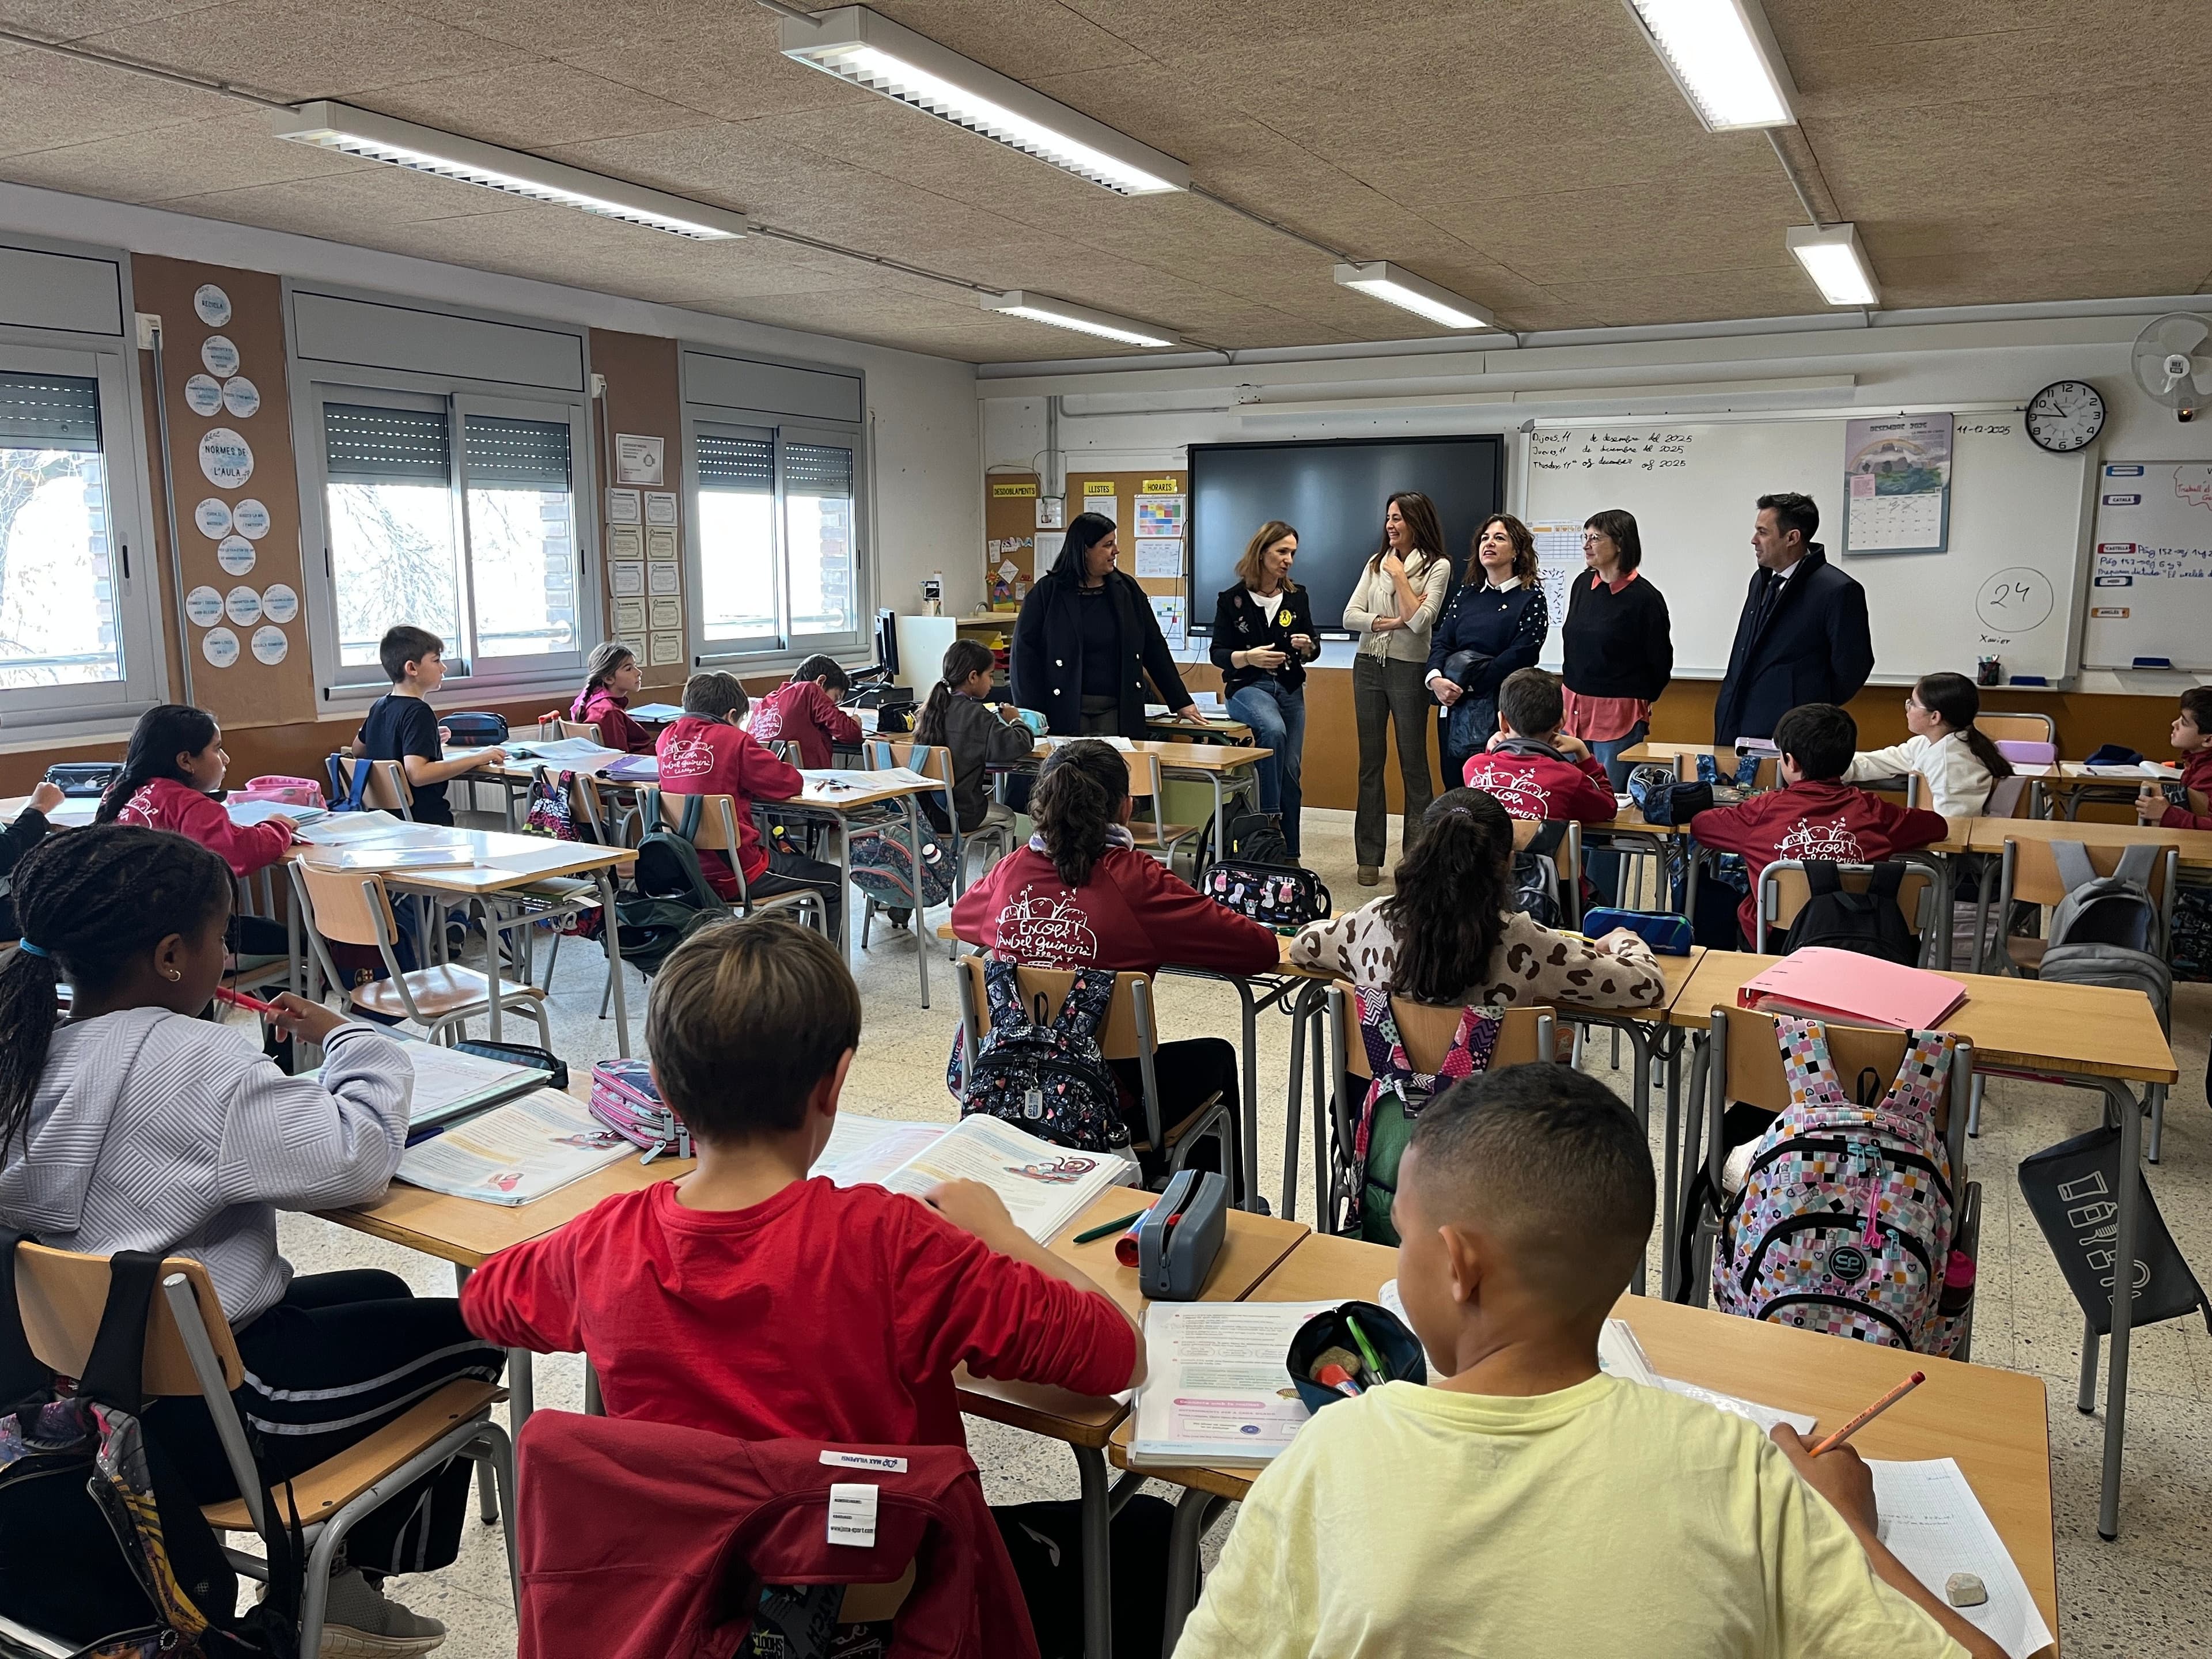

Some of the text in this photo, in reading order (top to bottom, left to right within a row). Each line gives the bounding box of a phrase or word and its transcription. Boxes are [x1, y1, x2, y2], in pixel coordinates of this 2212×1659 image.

[2062, 384, 2074, 392] 12
[2047, 390, 2054, 398] 11
[2029, 414, 2037, 422] 9
[1957, 425, 2012, 435] 11-12-2025
[1590, 433, 1598, 442] de
[1649, 433, 1660, 442] del
[1665, 434, 1693, 443] 2025
[2075, 437, 2082, 445] 5
[204, 445, 247, 456] NORMES DE
[1643, 444, 1653, 452] del
[1659, 445, 1684, 453] 2025
[1582, 458, 1594, 468] of
[1642, 460, 1655, 470] of
[214, 467, 241, 477] L'AULA
[994, 487, 1035, 496] DESDOBLAMENTS
[1088, 485, 1109, 493] LLISTES
[1147, 483, 1172, 492] HORARIS
[1990, 582, 2029, 608] 24
